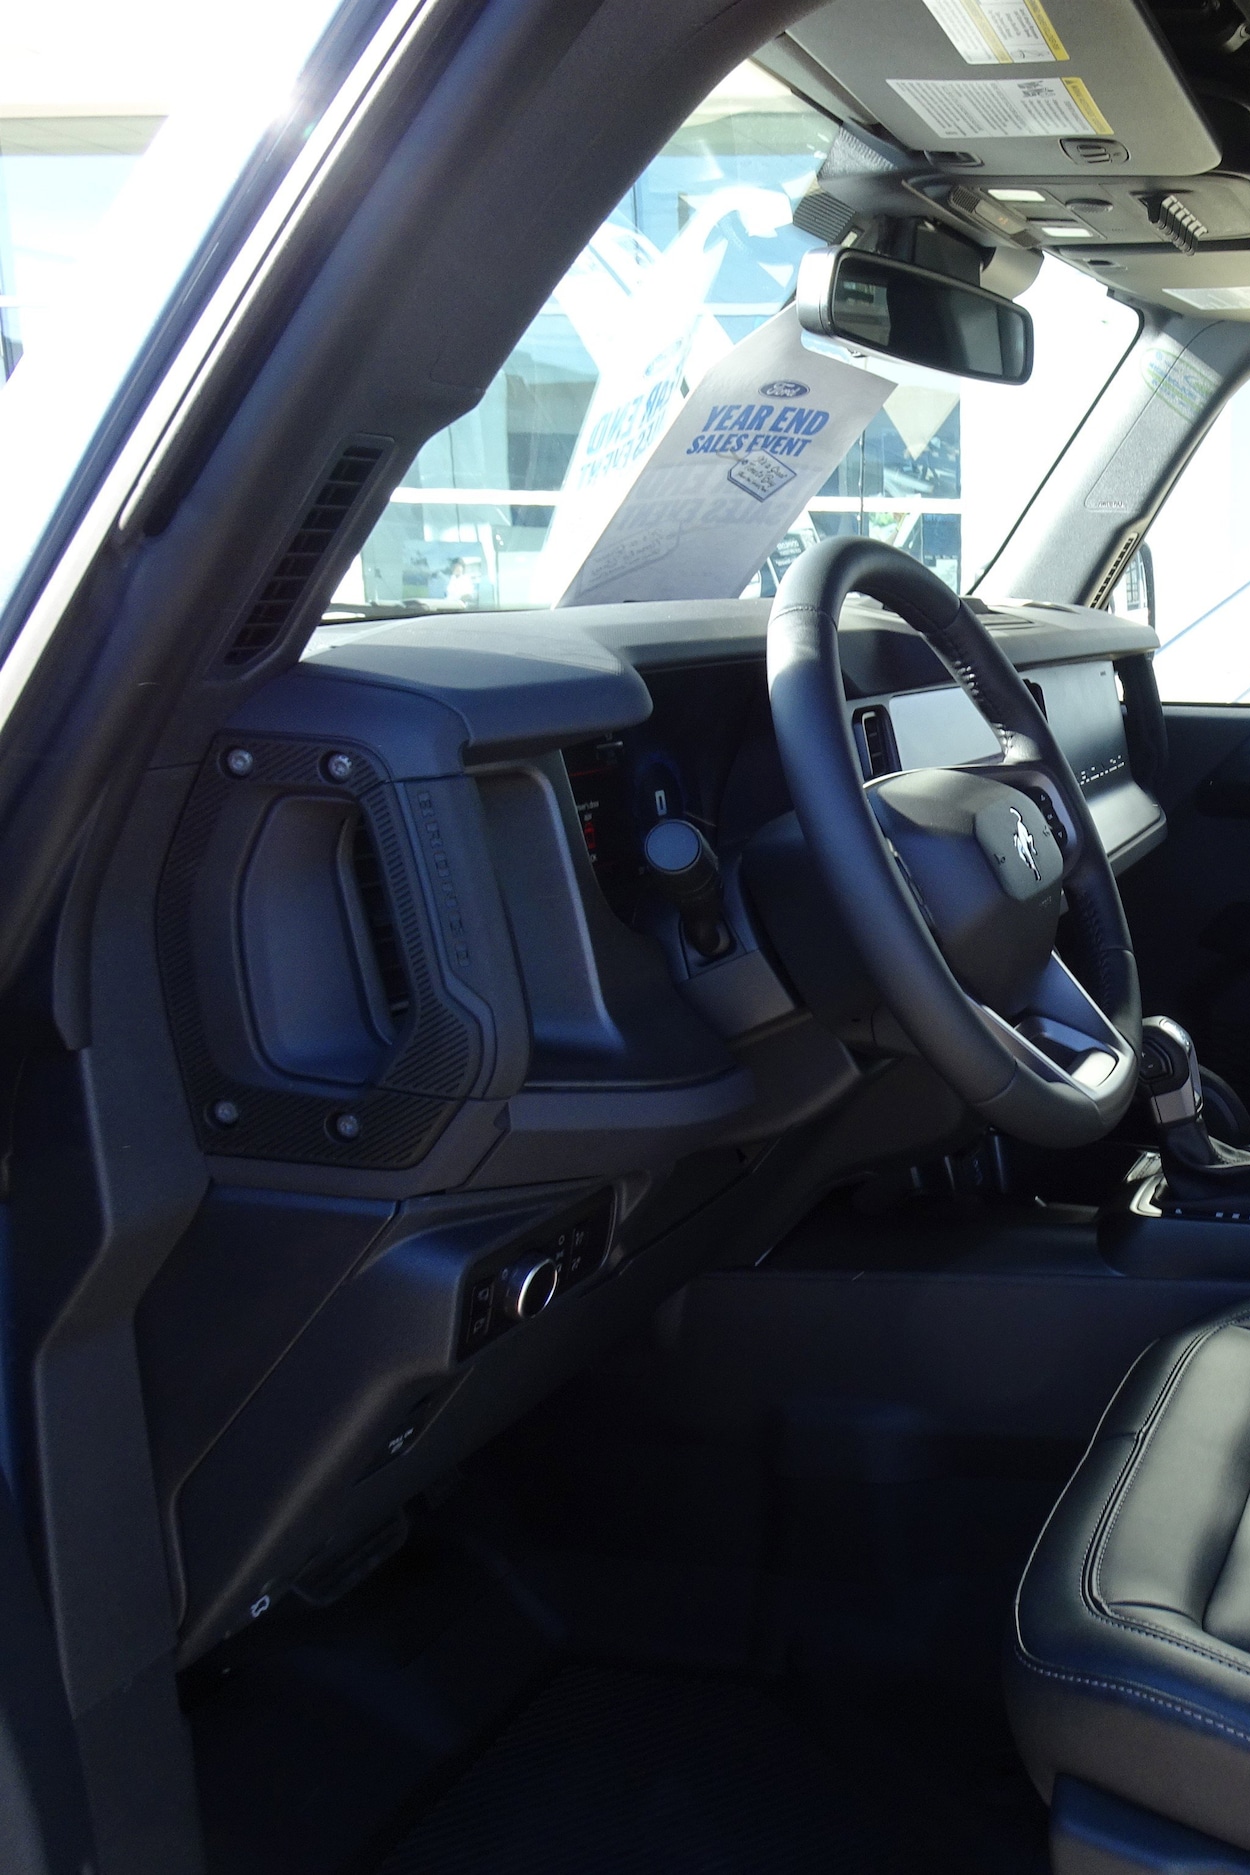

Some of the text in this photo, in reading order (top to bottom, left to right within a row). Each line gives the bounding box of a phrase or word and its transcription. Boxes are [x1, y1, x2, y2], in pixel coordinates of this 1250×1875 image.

[702, 404, 830, 436] YEAR END
[686, 433, 812, 457] SALES EVENT
[417, 791, 471, 968] BRONCO
